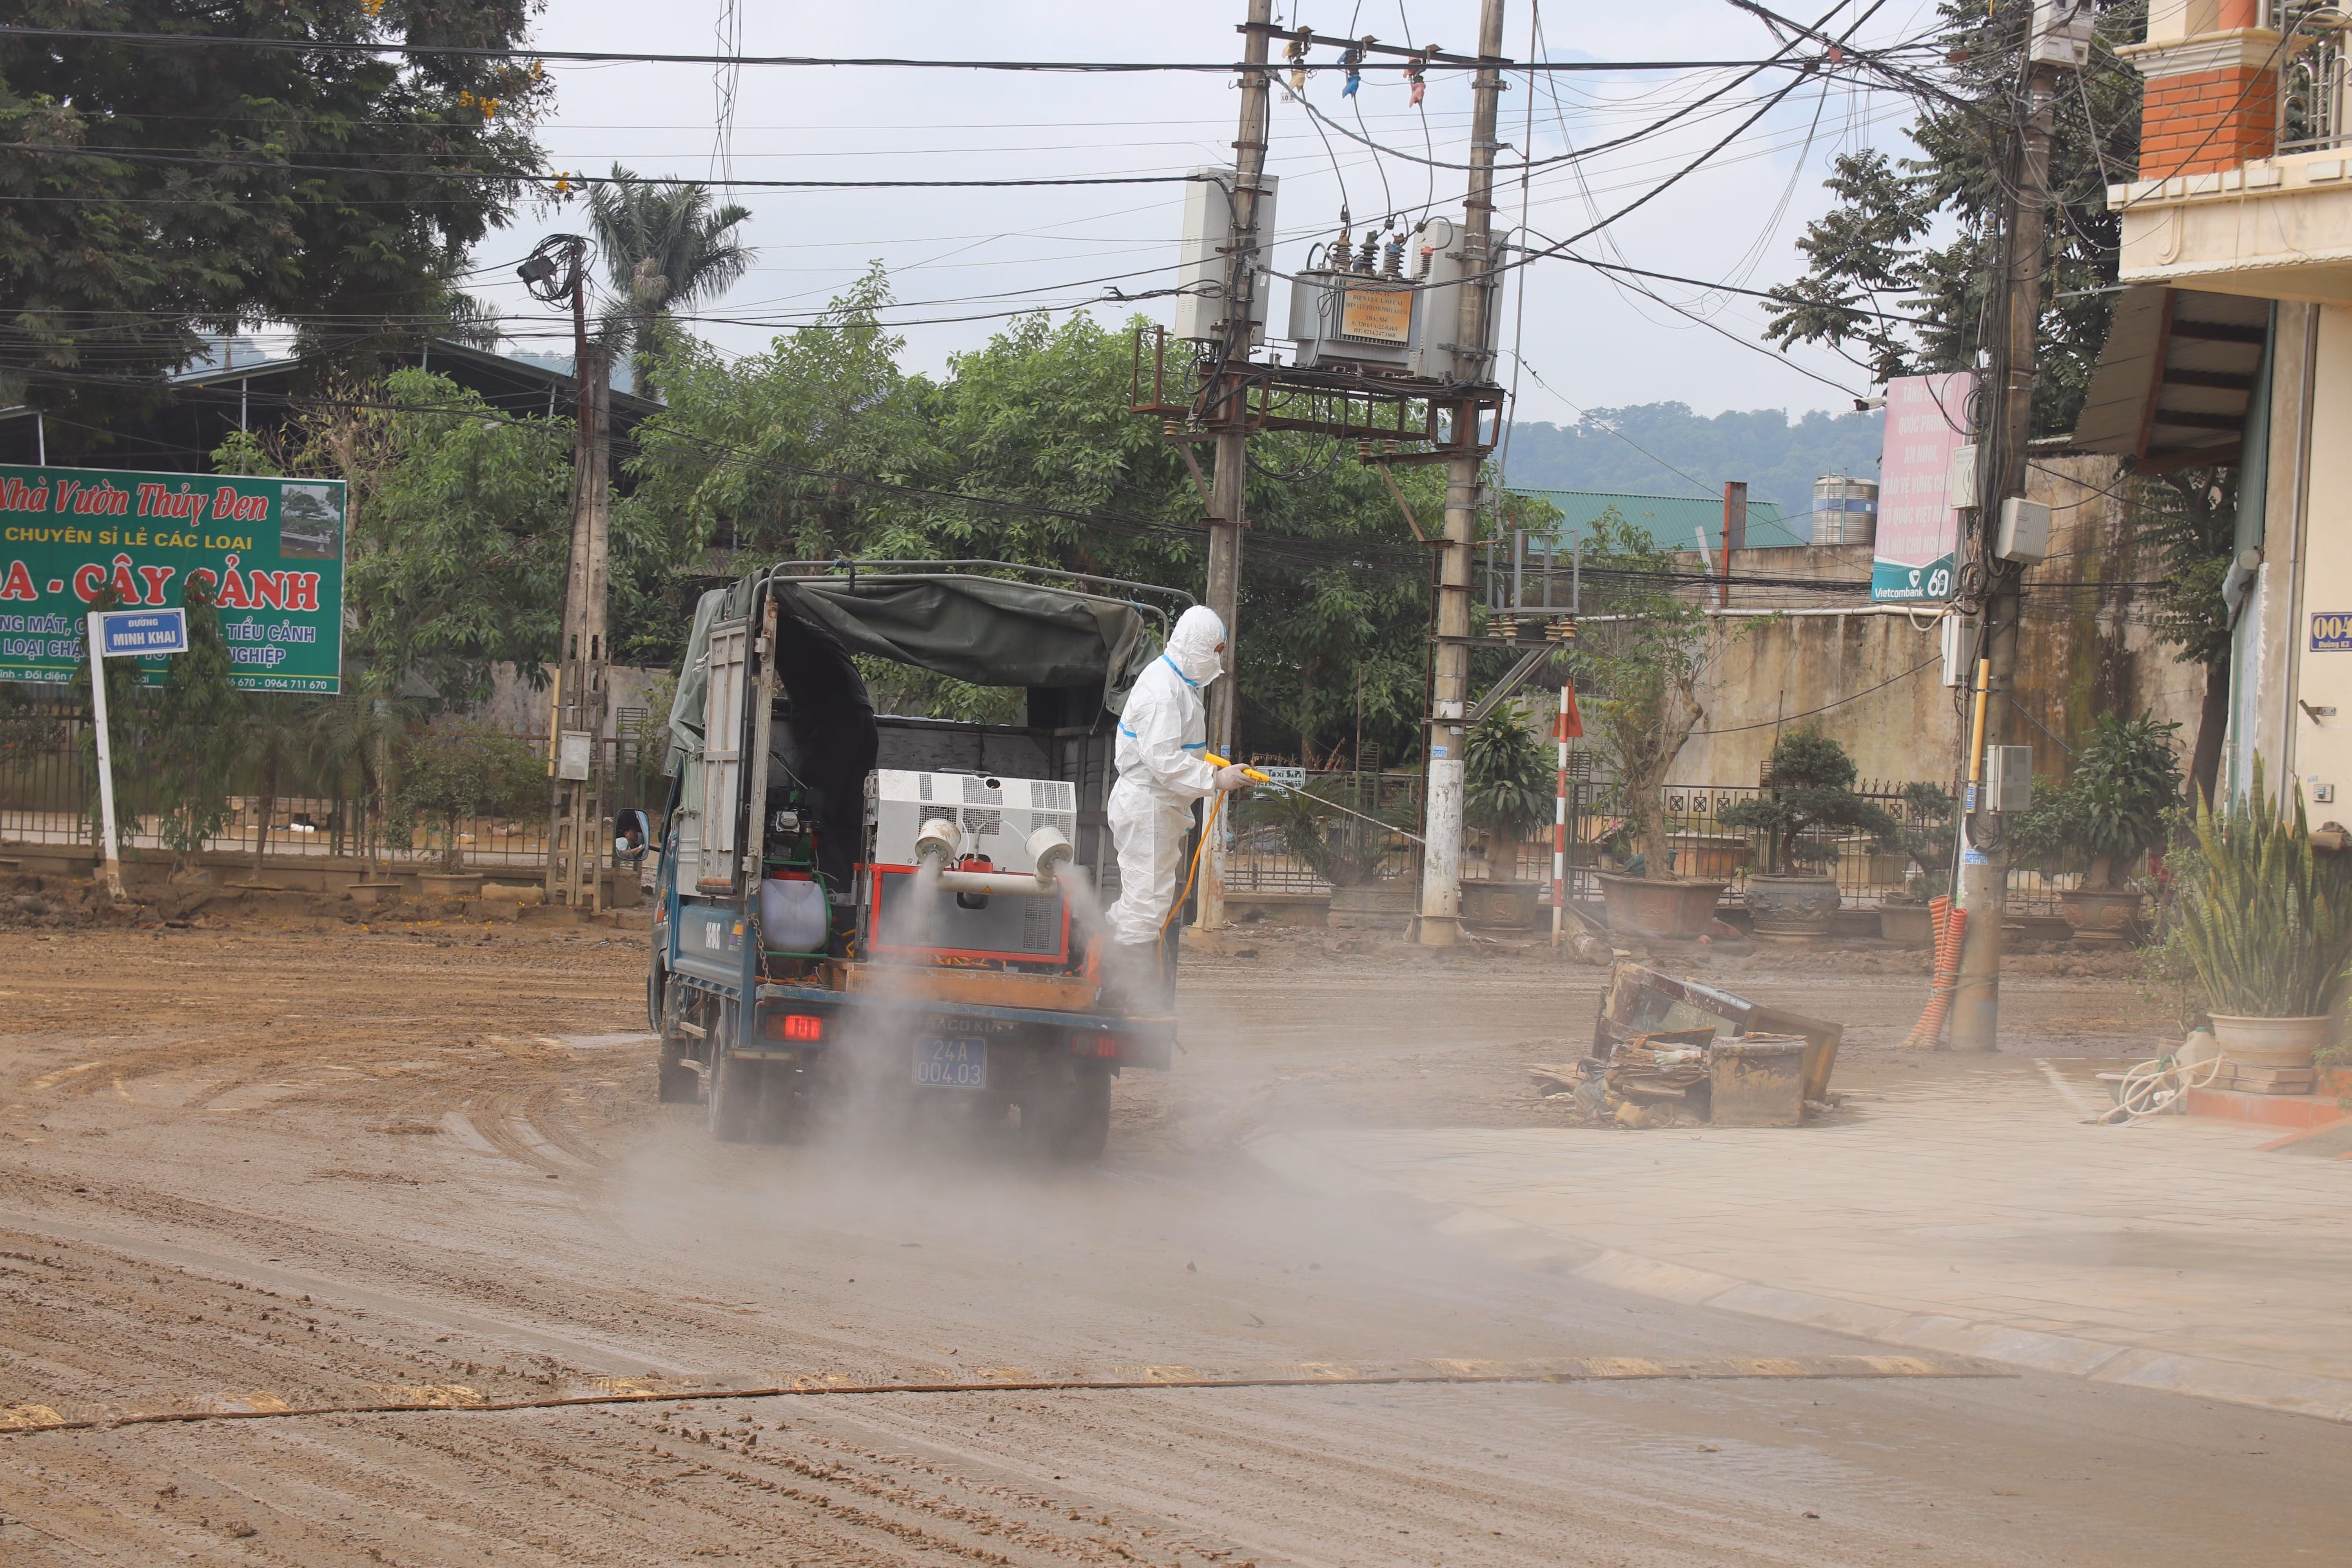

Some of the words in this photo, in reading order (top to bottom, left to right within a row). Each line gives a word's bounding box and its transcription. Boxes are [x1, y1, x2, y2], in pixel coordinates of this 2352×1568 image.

[1898, 410, 1919, 436] QUỐC
[1904, 446, 1915, 464] AN
[1883, 471, 1898, 495] BẢO
[1901, 473, 1910, 498] VỆ
[56, 479, 129, 516] Vườn
[137, 483, 209, 527] Thủy
[212, 486, 269, 521] Đen
[1893, 500, 1913, 526] QUỐC
[1916, 503, 1932, 527] VIỆT
[5, 526, 92, 543] CHUYÊN
[99, 526, 117, 544] SỈ
[125, 527, 147, 545] LẺ
[154, 530, 198, 548] CÁC
[205, 535, 252, 554] LOẠI
[1906, 530, 1920, 554] CHỦ
[73, 553, 175, 605] CÂY
[184, 554, 321, 612] CẢNH
[1875, 586, 1924, 598] Vietcombank
[1927, 568, 1949, 596] 60
[28, 613, 71, 636] MÁT,
[128, 617, 158, 628] ĐƯỜNG
[226, 616, 264, 641] TIỂU
[267, 619, 316, 643] CẢNH
[4, 638, 44, 660] LOẠI
[48, 637, 90, 662] CHẬ
[113, 632, 145, 646] MINH
[148, 630, 176, 644] KHAI
[227, 644, 286, 668] NGHIỆP
[25, 670, 42, 679] Đối
[45, 671, 67, 682] diện
[238, 678, 255, 687] 670
[265, 679, 288, 688] 0964
[290, 680, 306, 688] 711
[309, 681, 327, 690] 670
[933, 1040, 967, 1061] 24A
[919, 1062, 981, 1084] 004.03
